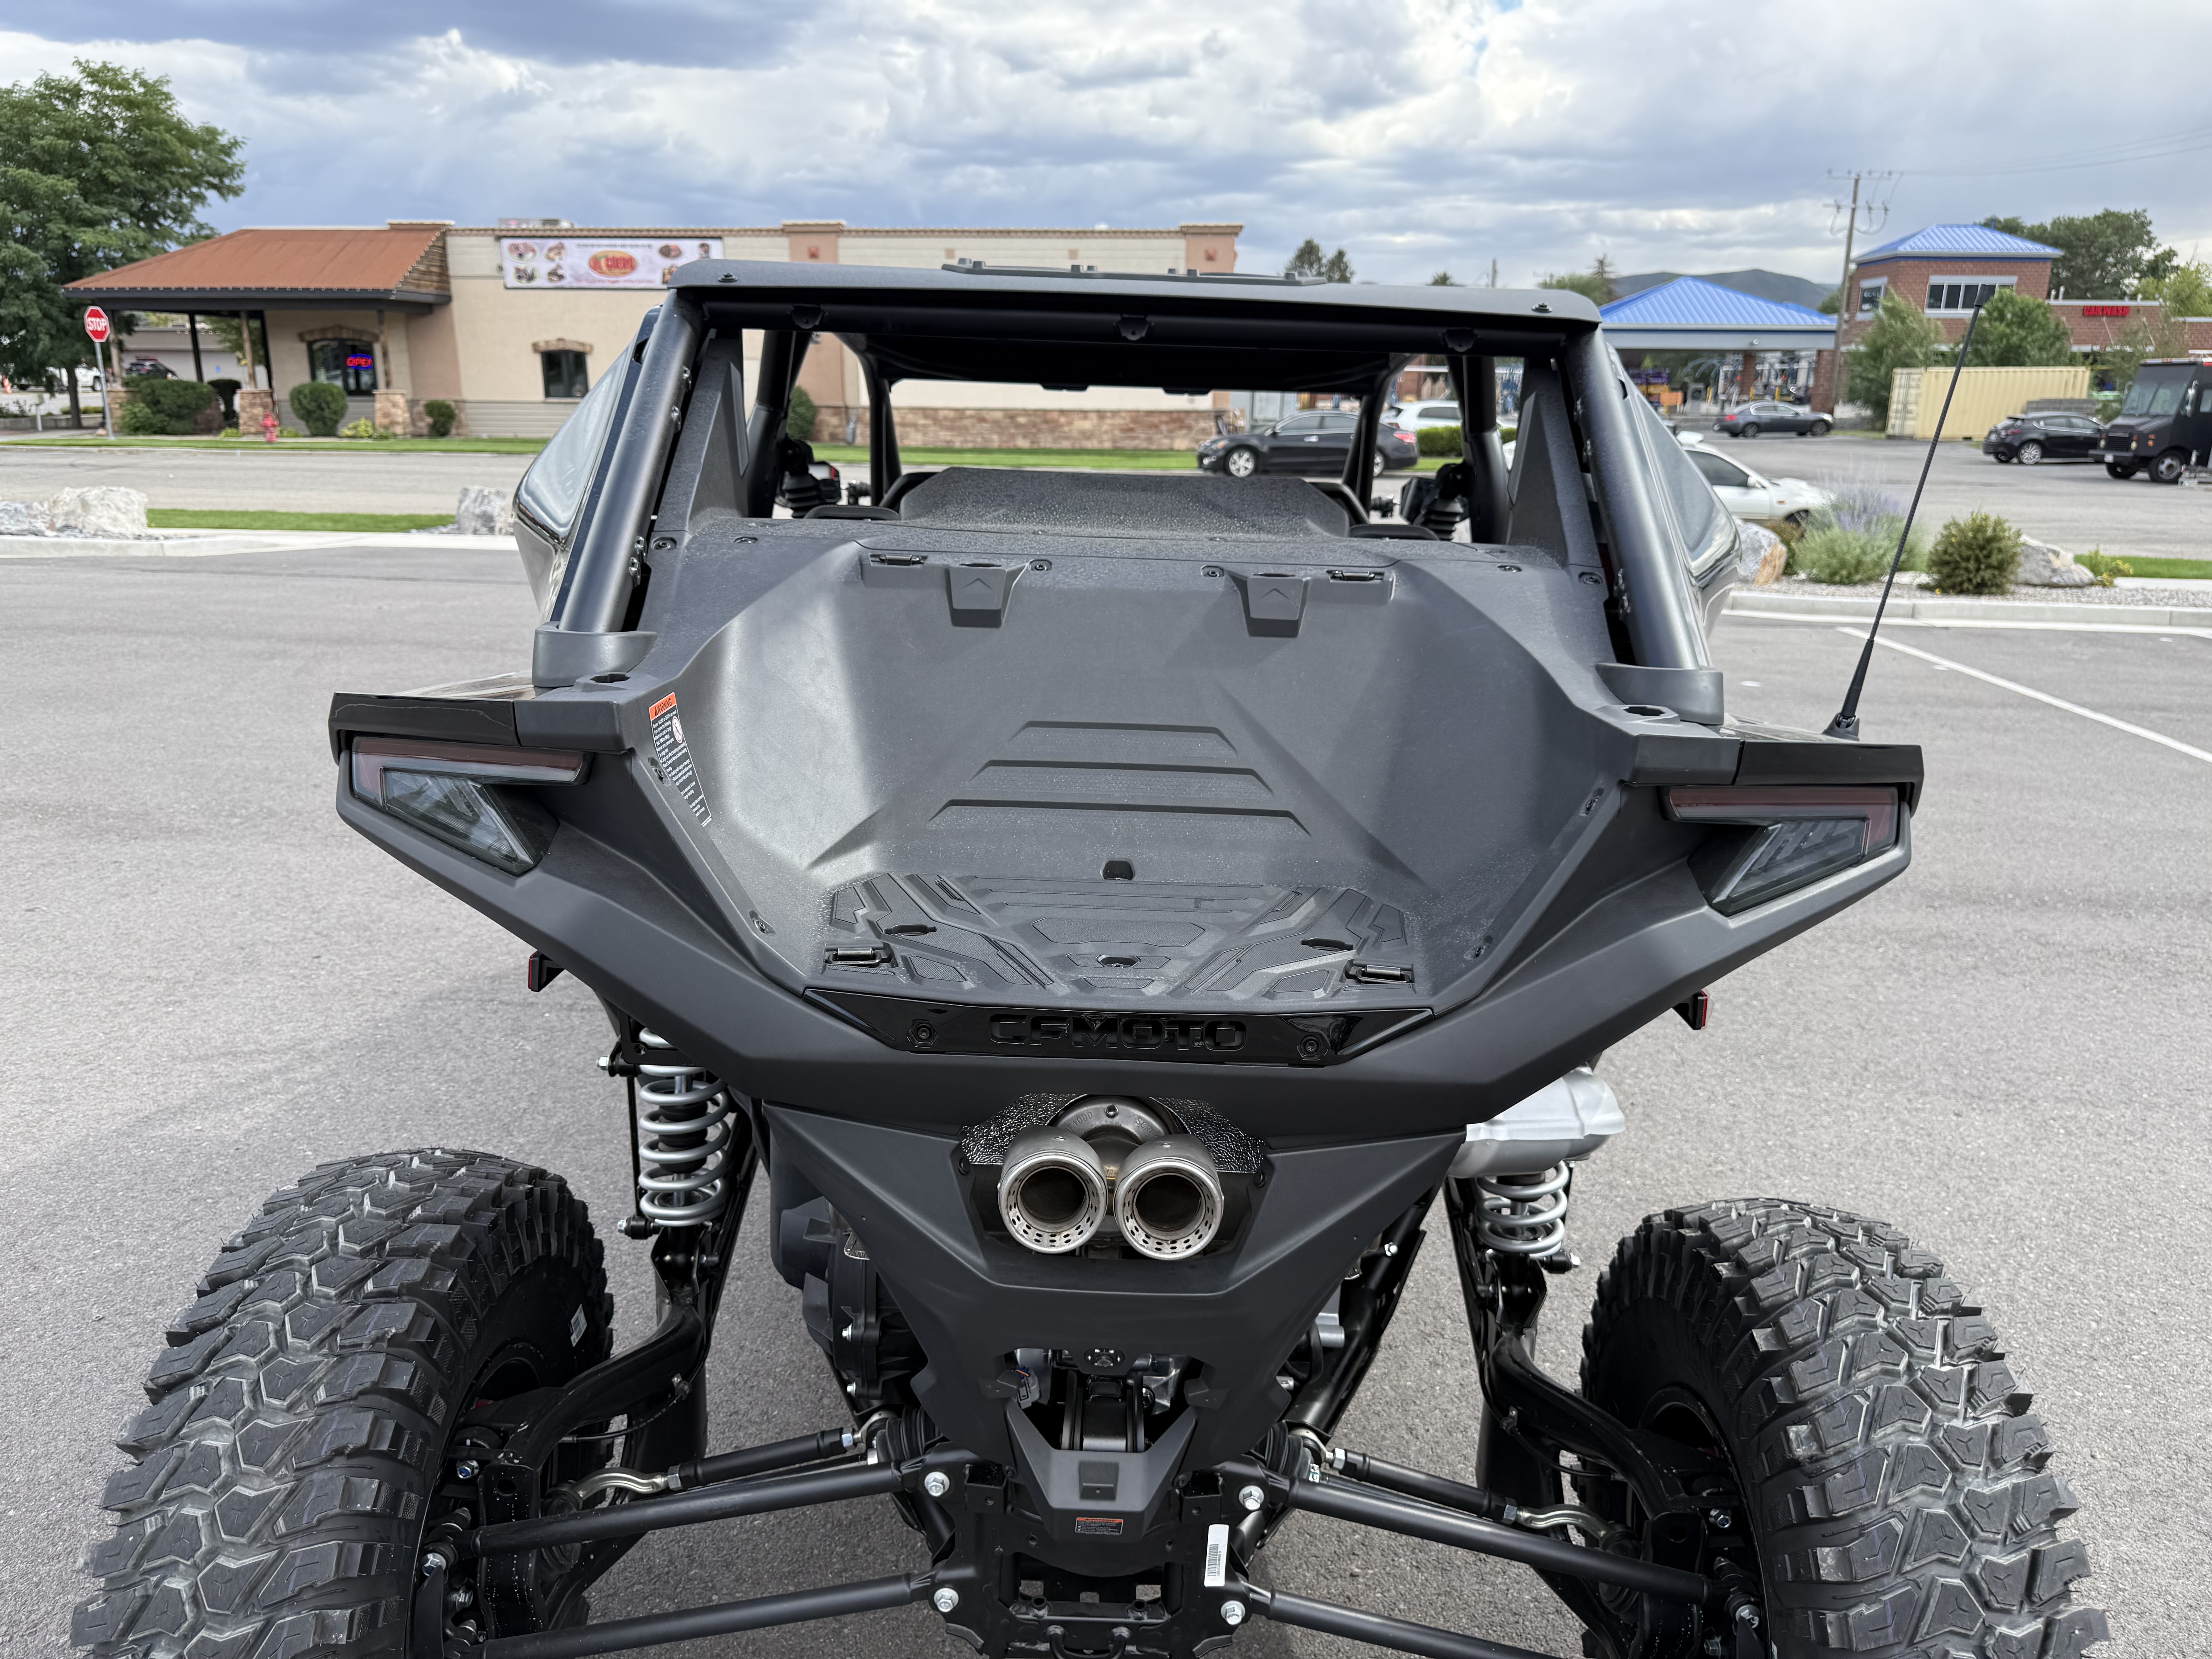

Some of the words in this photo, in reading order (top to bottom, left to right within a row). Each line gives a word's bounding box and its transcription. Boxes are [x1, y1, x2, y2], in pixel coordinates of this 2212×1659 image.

[2084, 306, 2102, 316] CAR
[2104, 306, 2130, 316] WASH
[88, 318, 107, 331] STOP
[656, 698, 672, 714] WARNING
[990, 1013, 1246, 1051] CFMOTO
